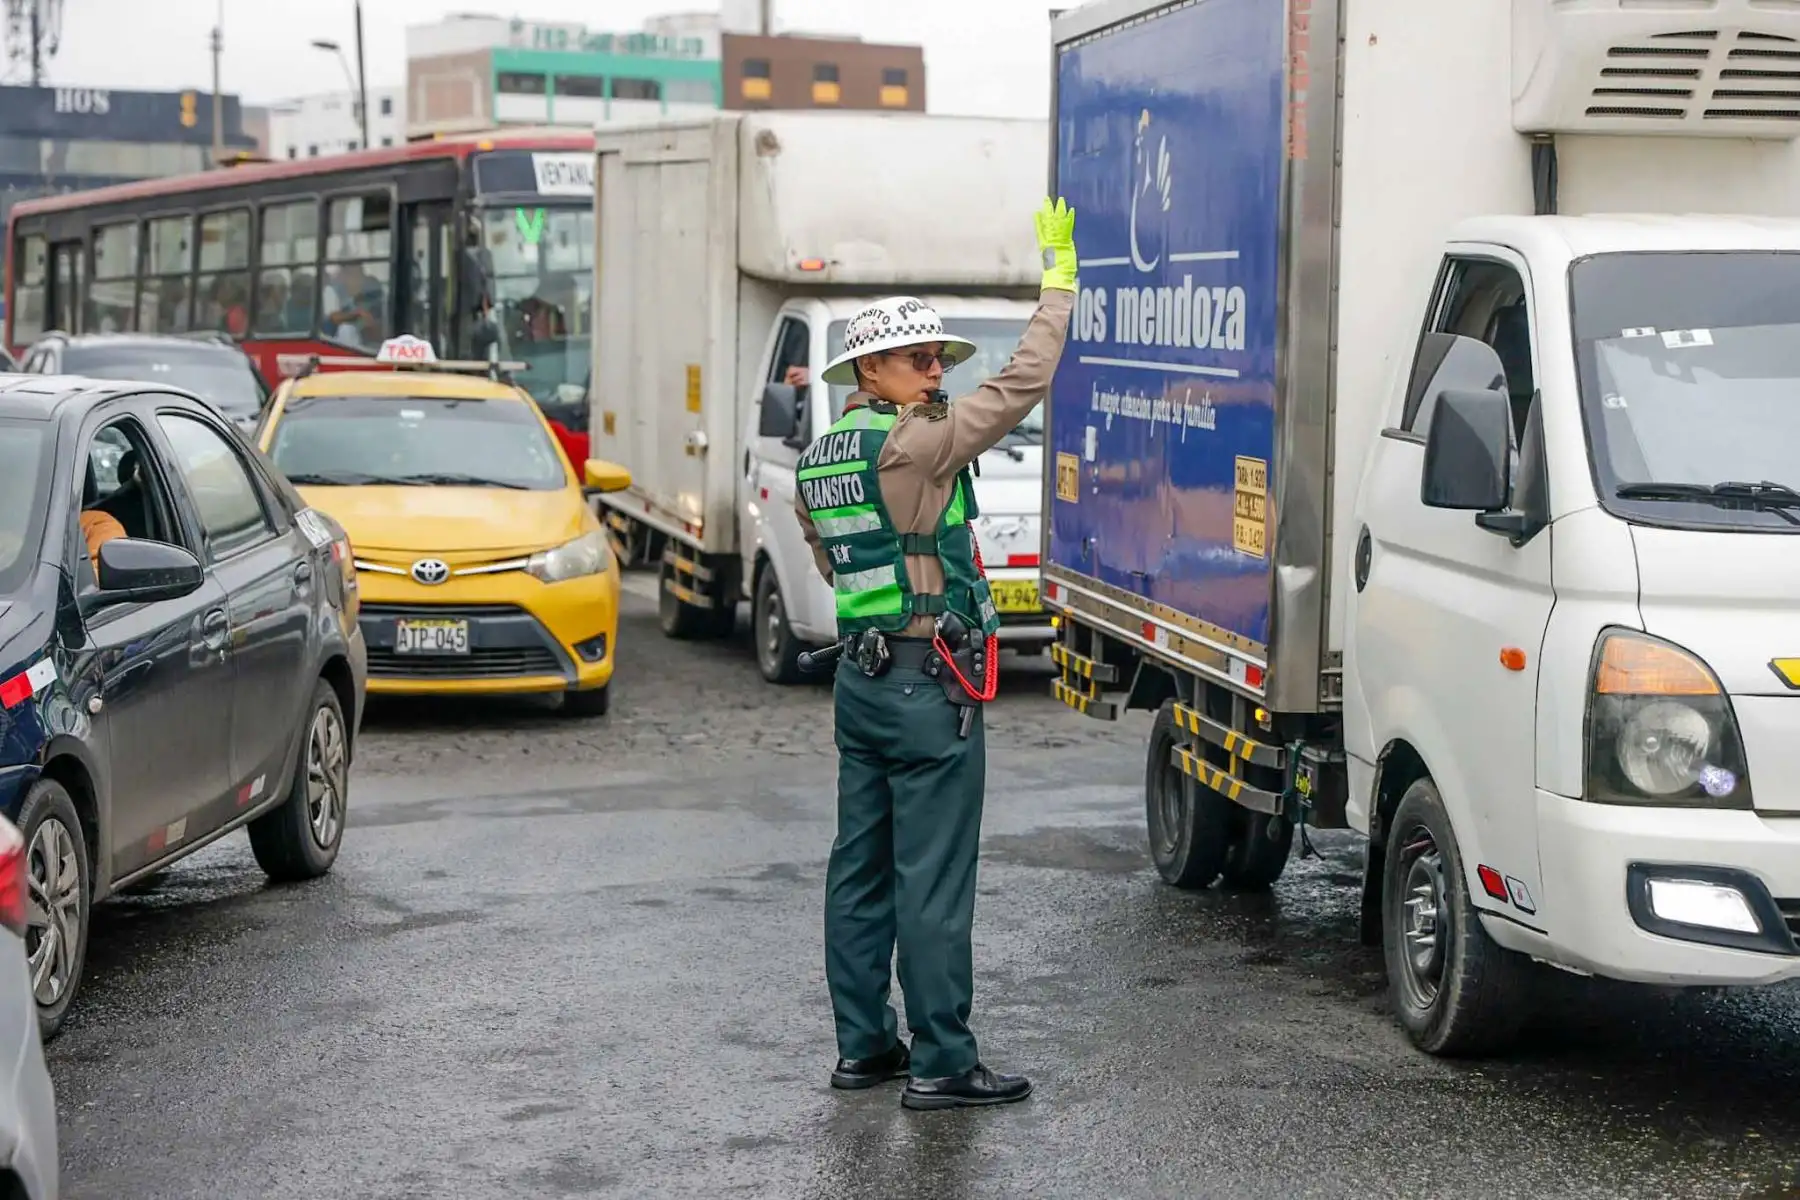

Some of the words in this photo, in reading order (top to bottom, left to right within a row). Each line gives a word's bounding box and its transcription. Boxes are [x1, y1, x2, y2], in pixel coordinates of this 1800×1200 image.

[1072, 277, 1107, 342] los
[1115, 274, 1246, 351] mendoza
[387, 343, 426, 358] TAXI
[1181, 387, 1216, 444] familia
[800, 431, 861, 468] POLICIA
[802, 473, 865, 509] TRANSITO
[990, 587, 1039, 607] TW-947
[398, 627, 467, 649] ATP-045
